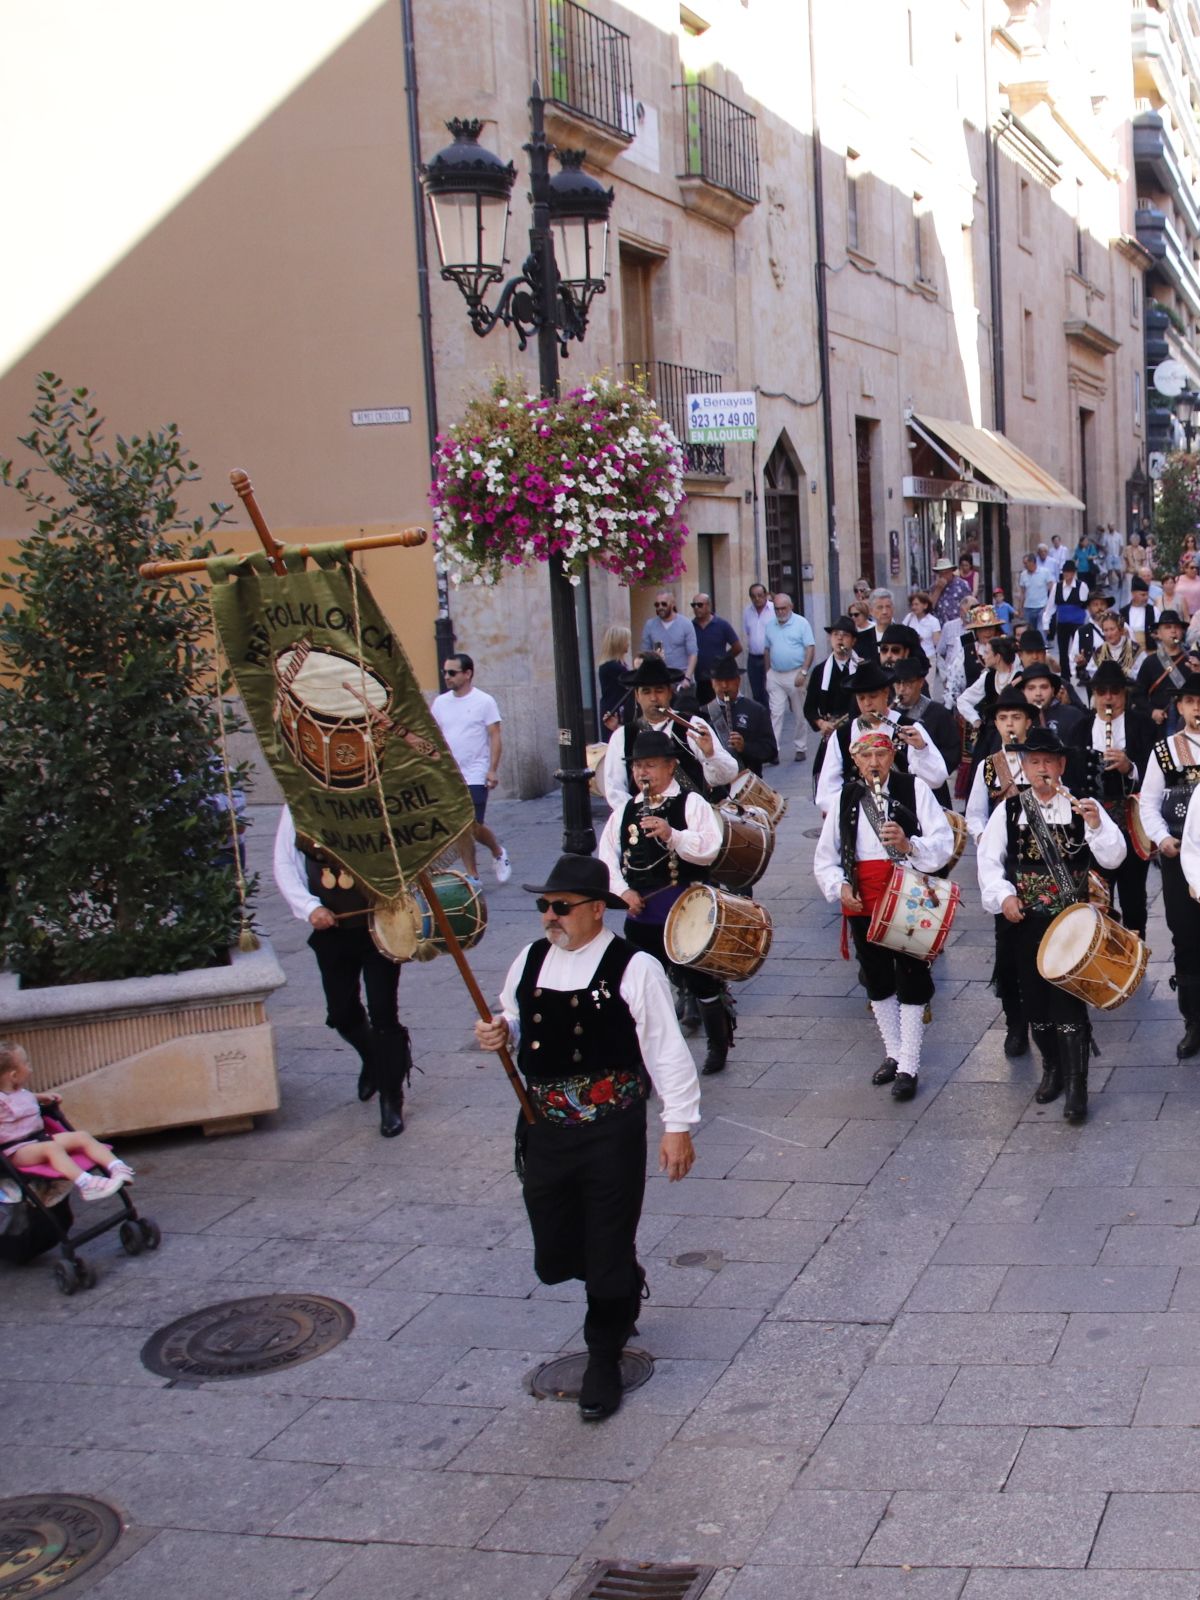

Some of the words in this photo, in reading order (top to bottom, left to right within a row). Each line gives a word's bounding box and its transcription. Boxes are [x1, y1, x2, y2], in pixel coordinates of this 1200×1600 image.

[703, 397, 753, 408] Benayas
[691, 414, 710, 428] 923
[713, 413, 725, 427] 12
[728, 412, 740, 426] 49
[743, 411, 755, 426] 00
[691, 431, 705, 443] EN
[706, 428, 755, 442] ALQUILER
[264, 602, 394, 659] FOLKLORCA
